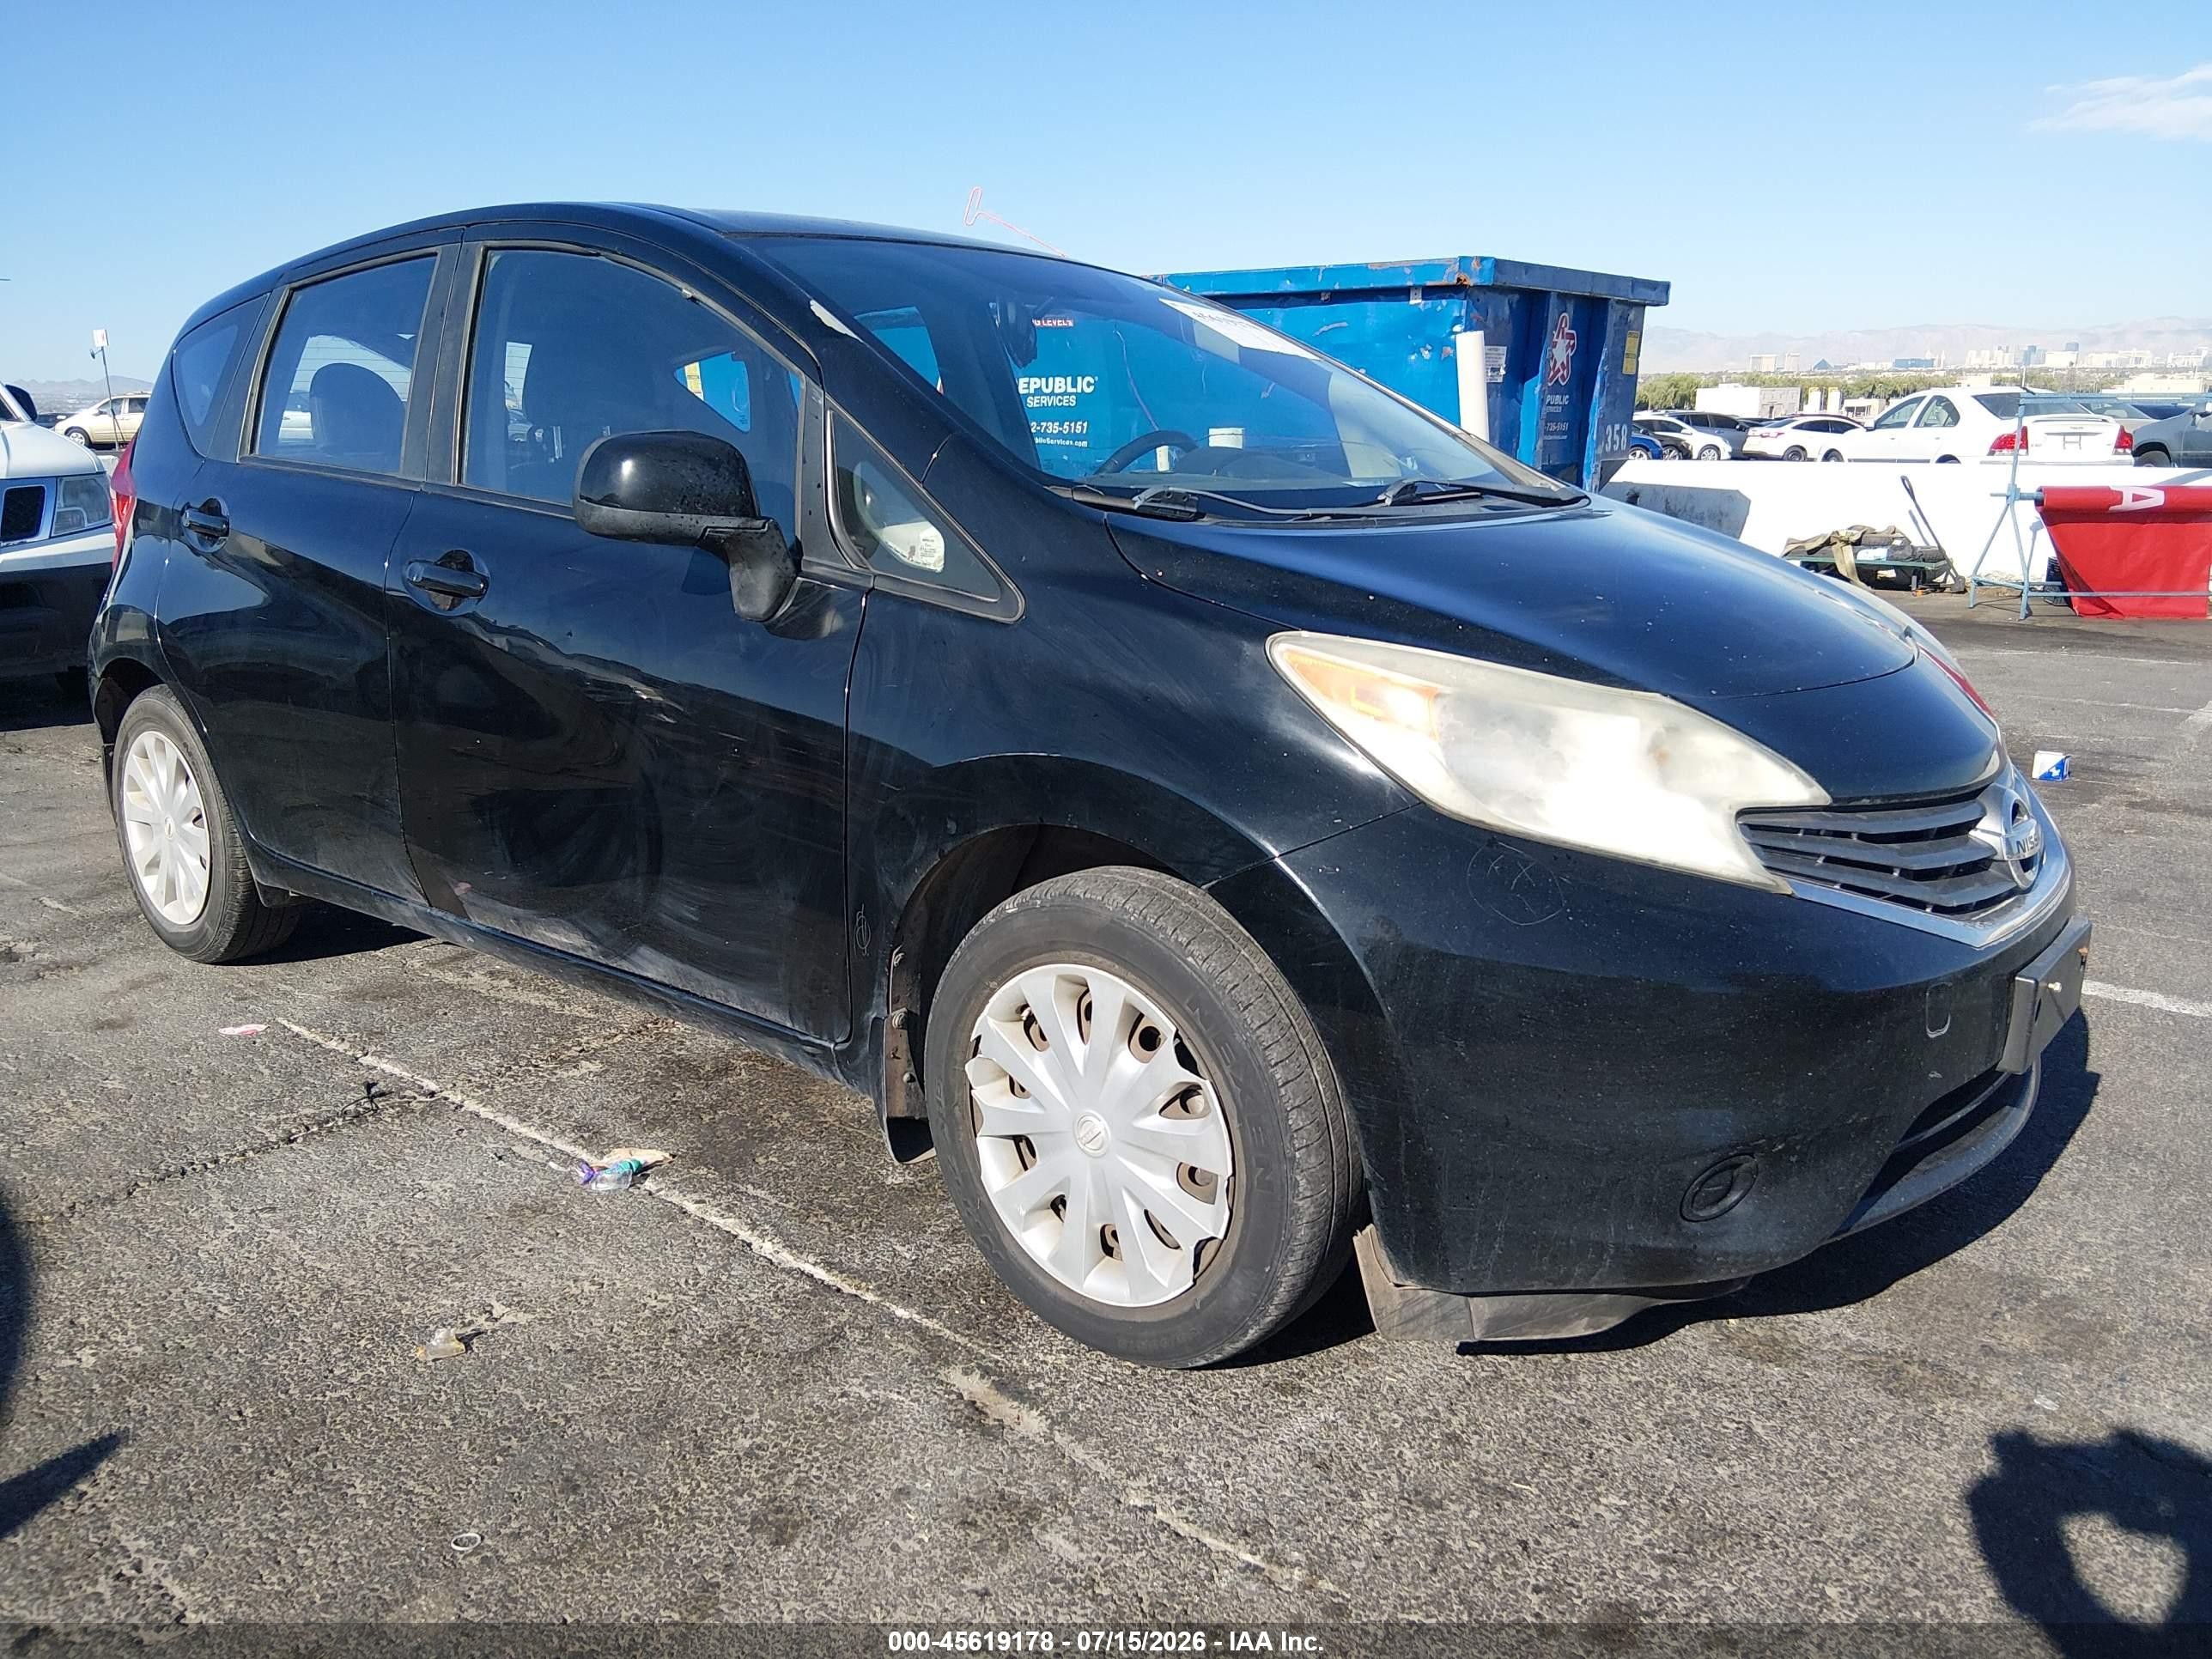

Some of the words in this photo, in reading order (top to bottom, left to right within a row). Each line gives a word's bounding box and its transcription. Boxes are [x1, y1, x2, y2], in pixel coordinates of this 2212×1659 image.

[1018, 376, 1095, 394] EPUBLIC
[1026, 395, 1077, 407] SERVICES
[1546, 394, 1570, 404] PUBLIC
[1034, 436, 1088, 447] blicServices.com
